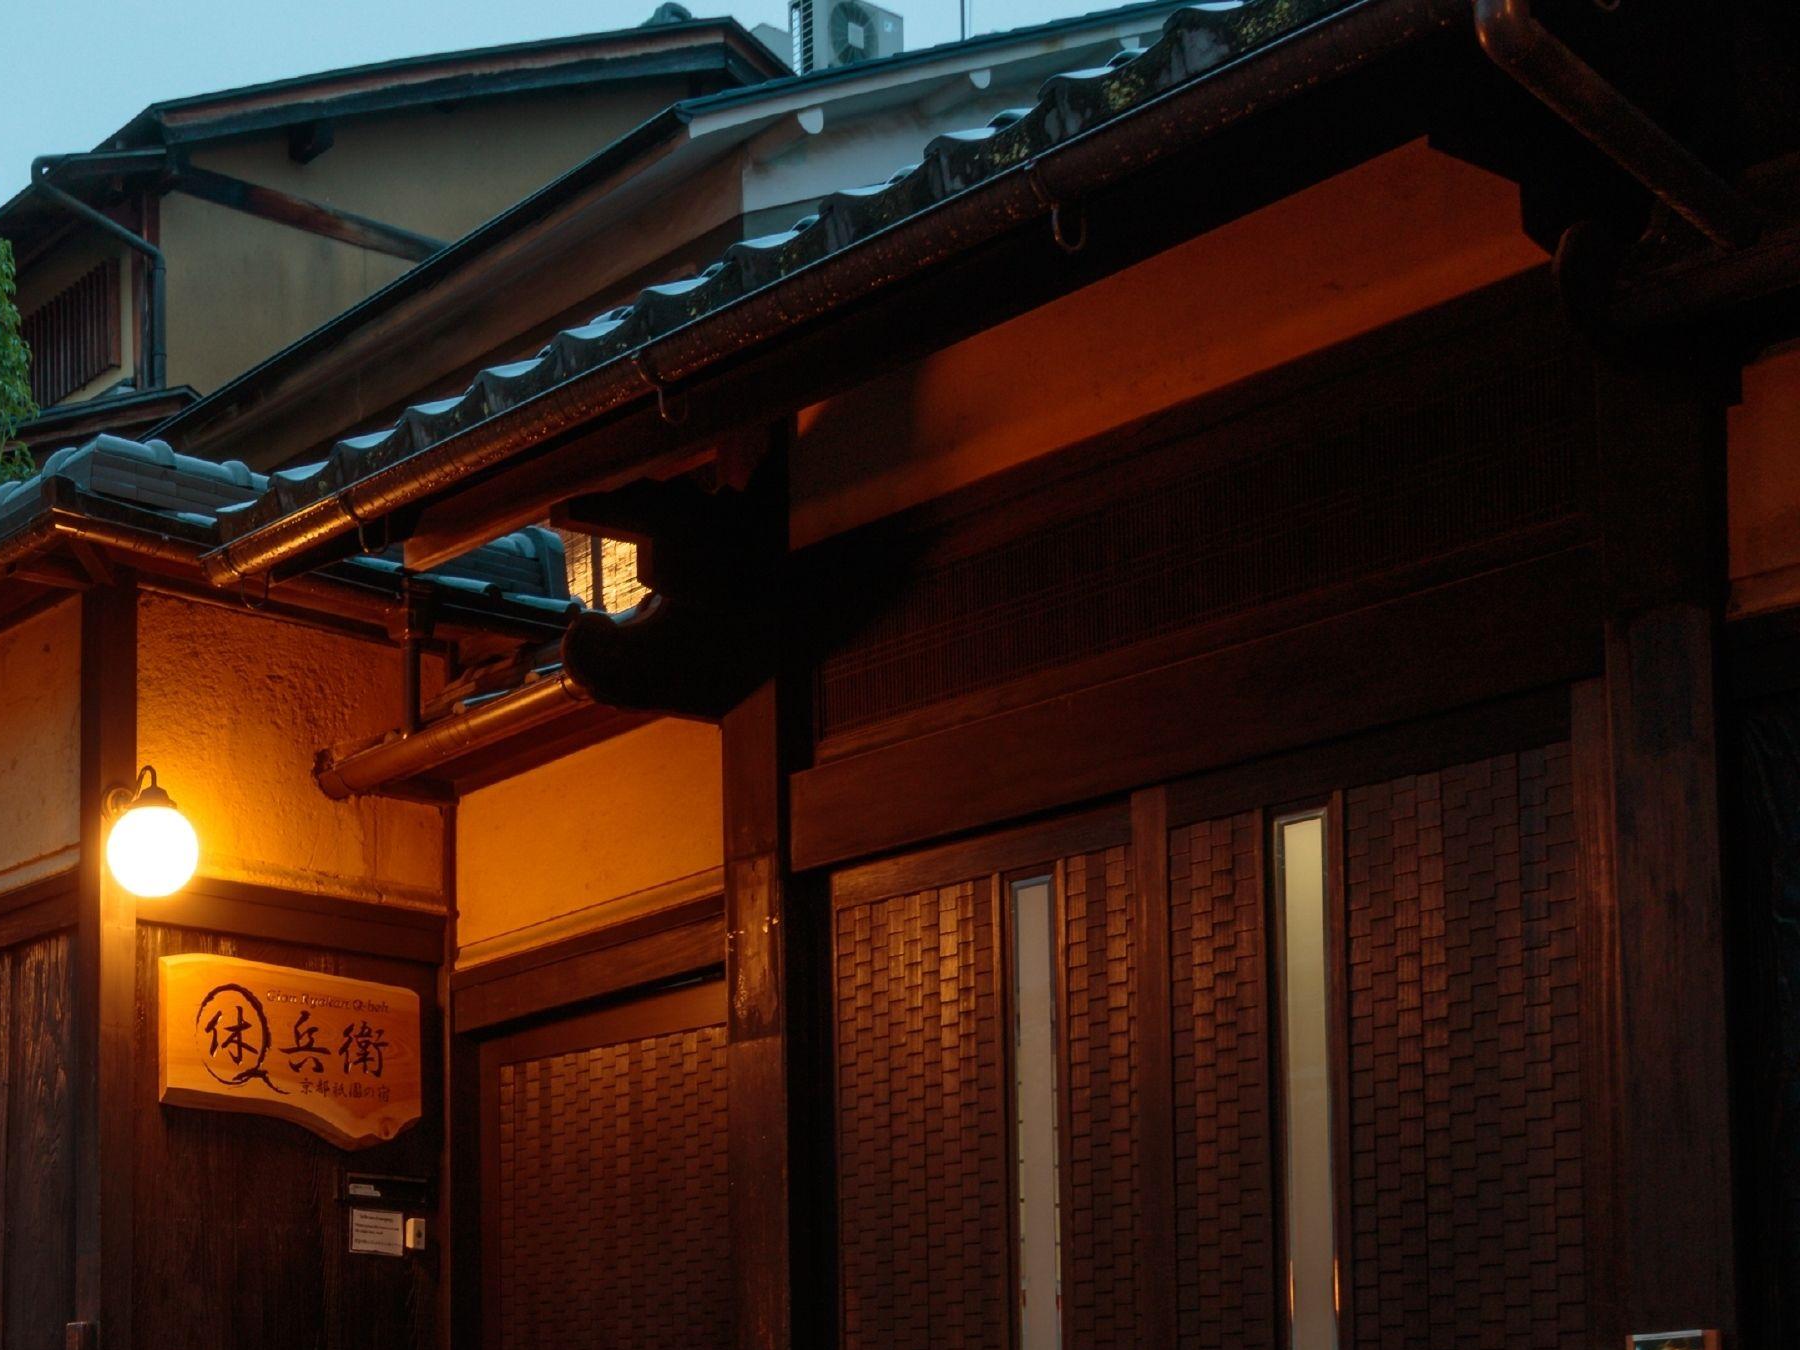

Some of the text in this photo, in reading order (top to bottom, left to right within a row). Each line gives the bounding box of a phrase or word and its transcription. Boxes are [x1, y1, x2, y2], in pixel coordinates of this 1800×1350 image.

[267, 990, 389, 1014] Gion Ryokan Q-beh
